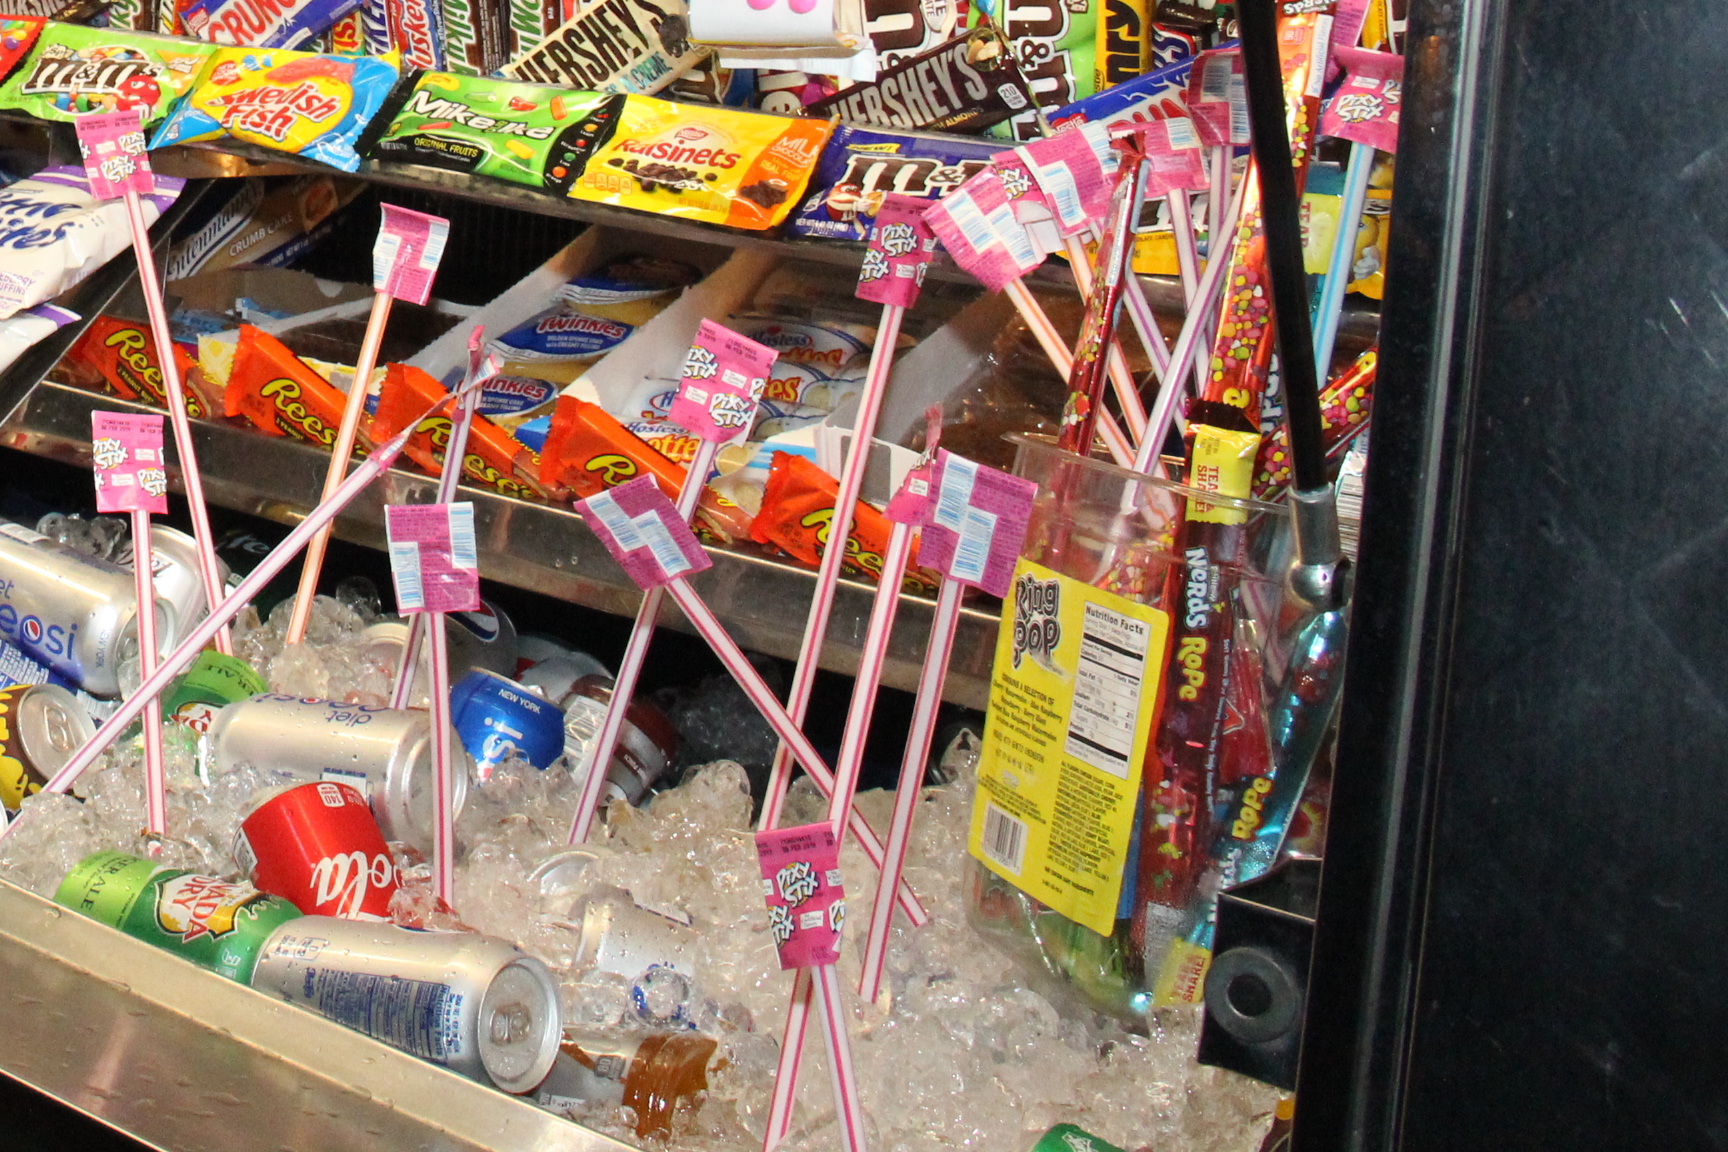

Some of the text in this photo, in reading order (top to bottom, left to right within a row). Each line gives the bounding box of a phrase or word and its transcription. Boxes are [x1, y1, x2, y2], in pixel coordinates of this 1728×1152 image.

[827, 40, 988, 128] HERSHEY'S
[204, 81, 343, 128] Swedish
[220, 101, 297, 142] Fish
[404, 90, 498, 132] Mike
[414, 137, 479, 158] ORIGINAL FRUITS
[611, 135, 743, 171] Raisinets
[536, 314, 629, 338] Twinkies
[1015, 573, 1059, 622] Ring
[1086, 605, 1144, 635] Nutrition Facts
[498, 687, 542, 715] NEW YORK
